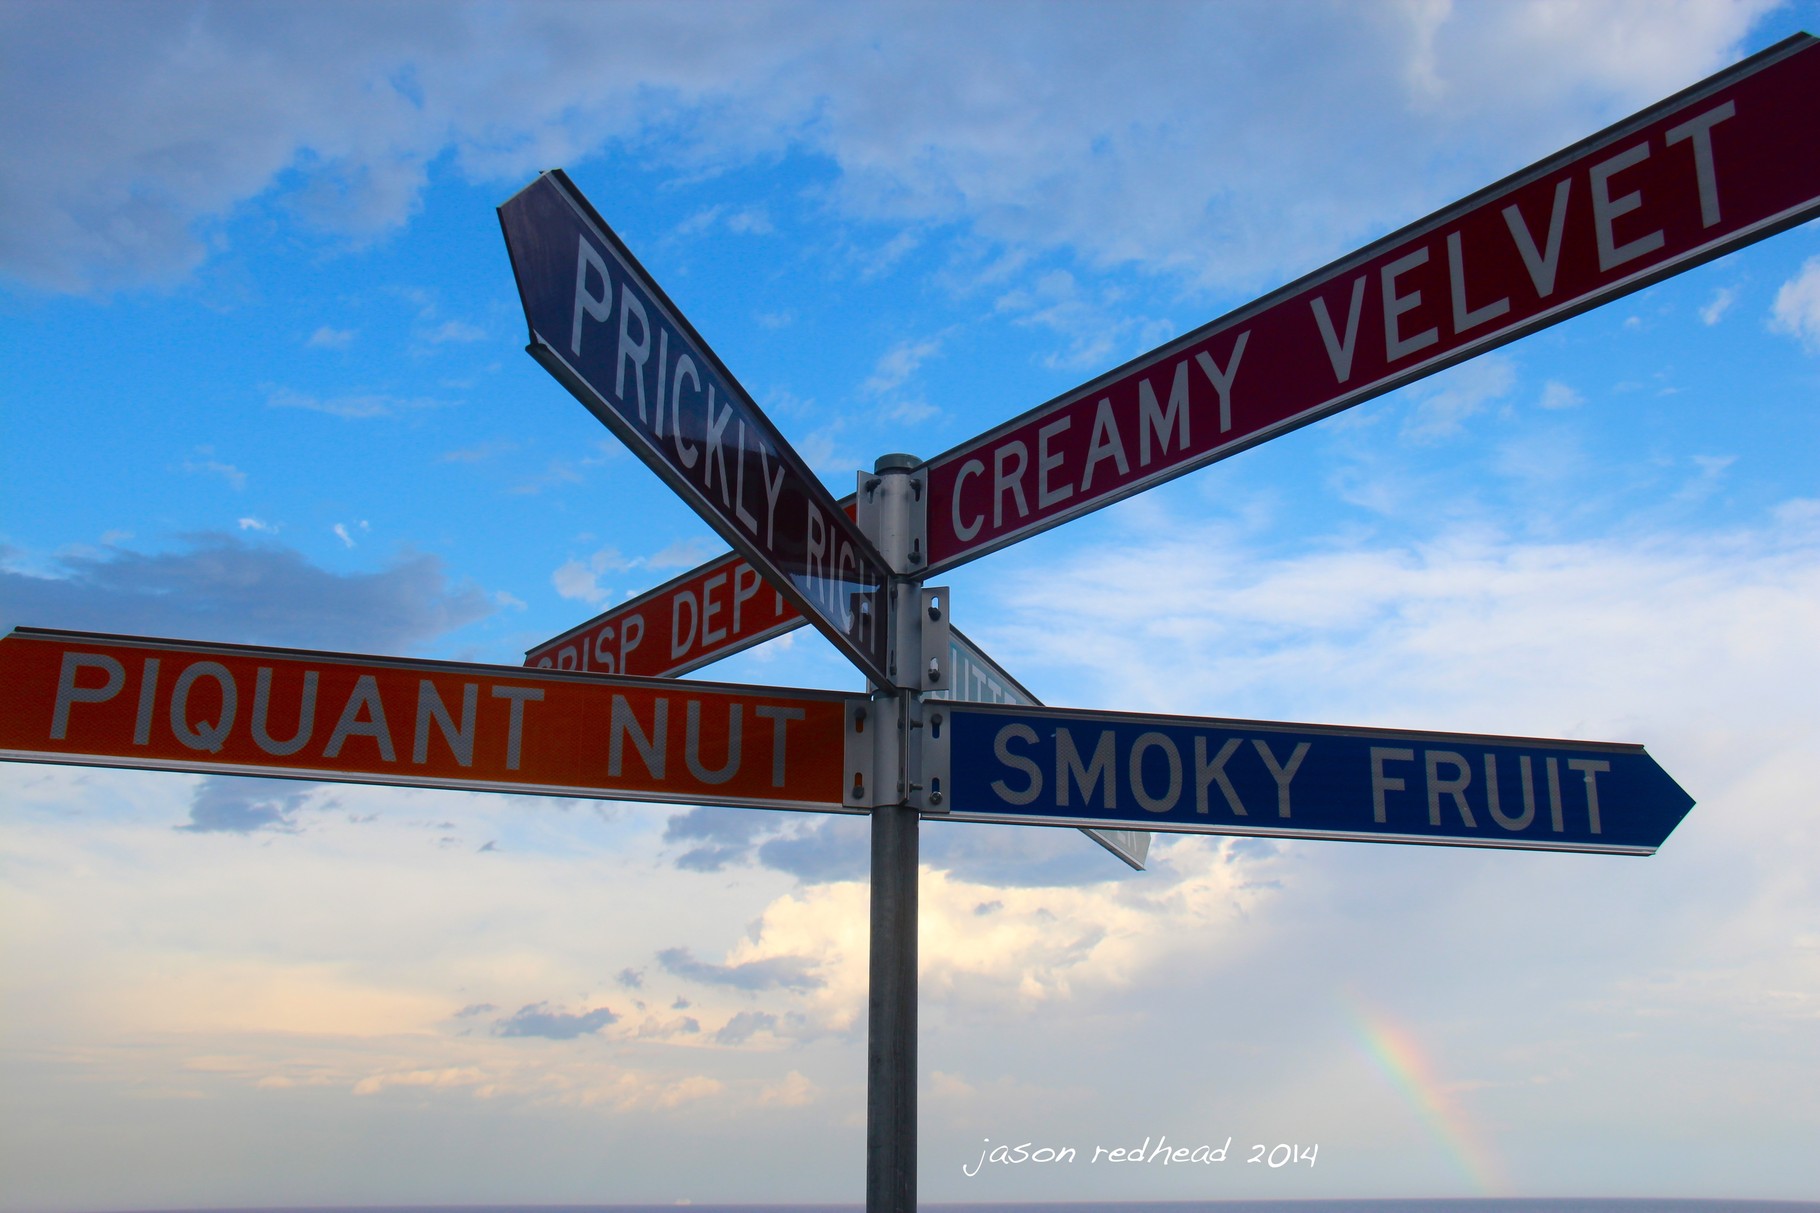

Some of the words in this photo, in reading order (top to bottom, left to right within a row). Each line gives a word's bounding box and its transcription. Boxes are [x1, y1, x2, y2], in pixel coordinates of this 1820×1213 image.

[951, 329, 1251, 543] CREAMY
[1310, 99, 1736, 384] VELVET
[571, 233, 787, 552] PRICKLY
[806, 499, 876, 655] RICH
[537, 613, 645, 675] ISP
[49, 650, 546, 770] PIQUANT
[608, 693, 806, 788] NUT
[990, 722, 1311, 818] SMOKY
[1370, 747, 1610, 835] FRUIT
